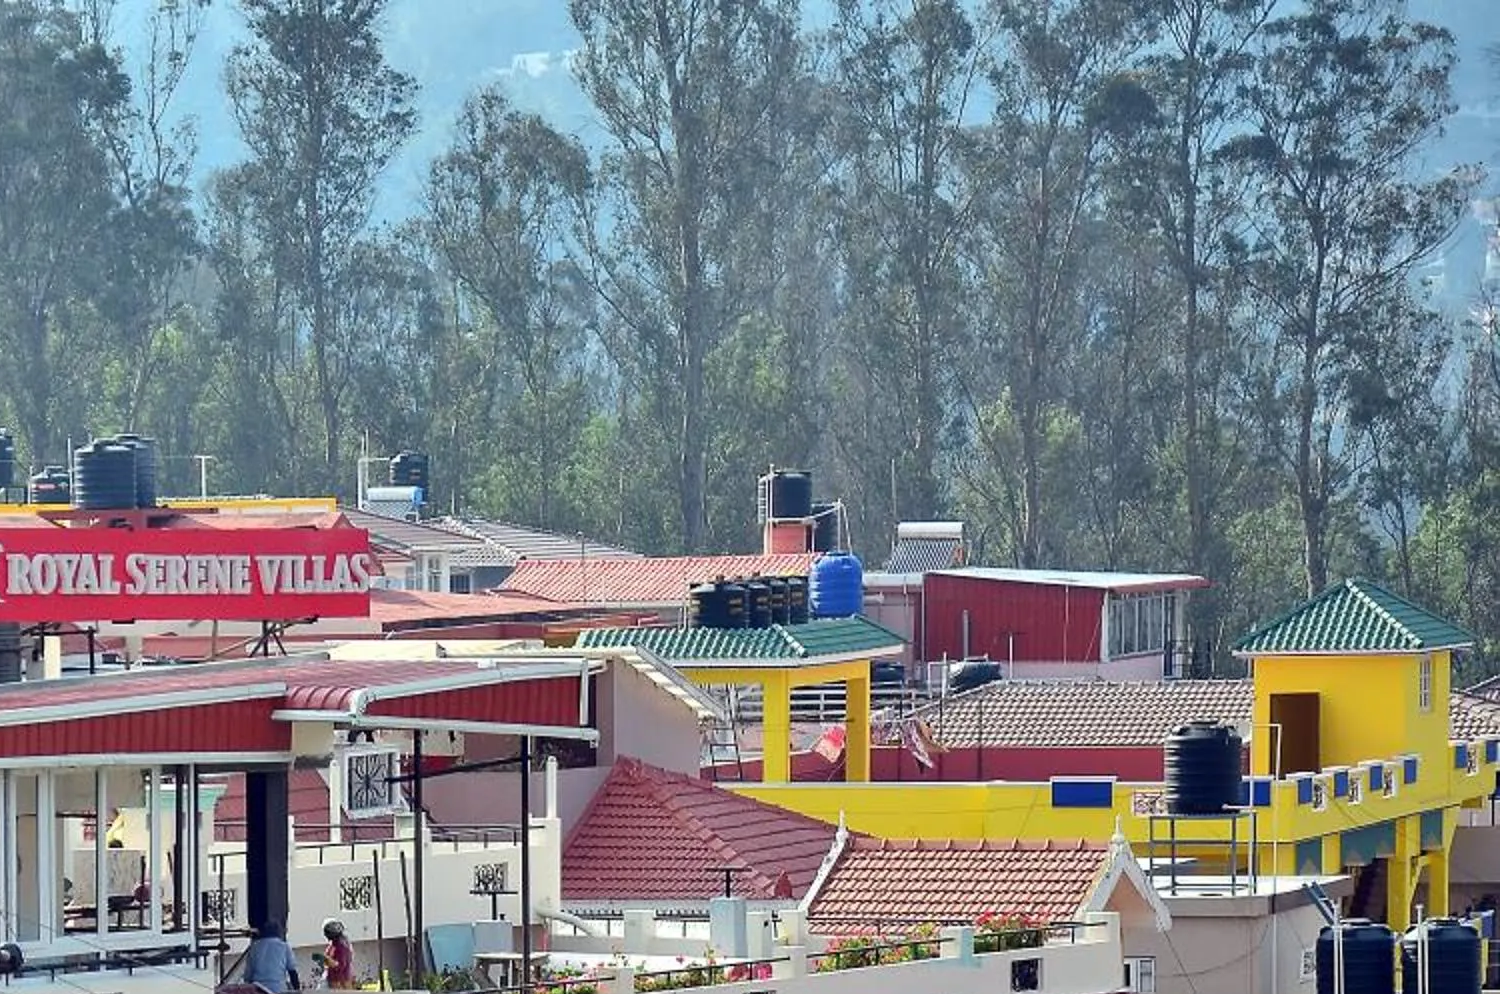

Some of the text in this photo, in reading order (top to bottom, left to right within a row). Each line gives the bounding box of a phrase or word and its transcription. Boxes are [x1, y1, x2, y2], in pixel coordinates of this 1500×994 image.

[6, 553, 121, 595] ROYAL
[125, 553, 252, 595] SERENE
[255, 553, 370, 594] VILLAS
